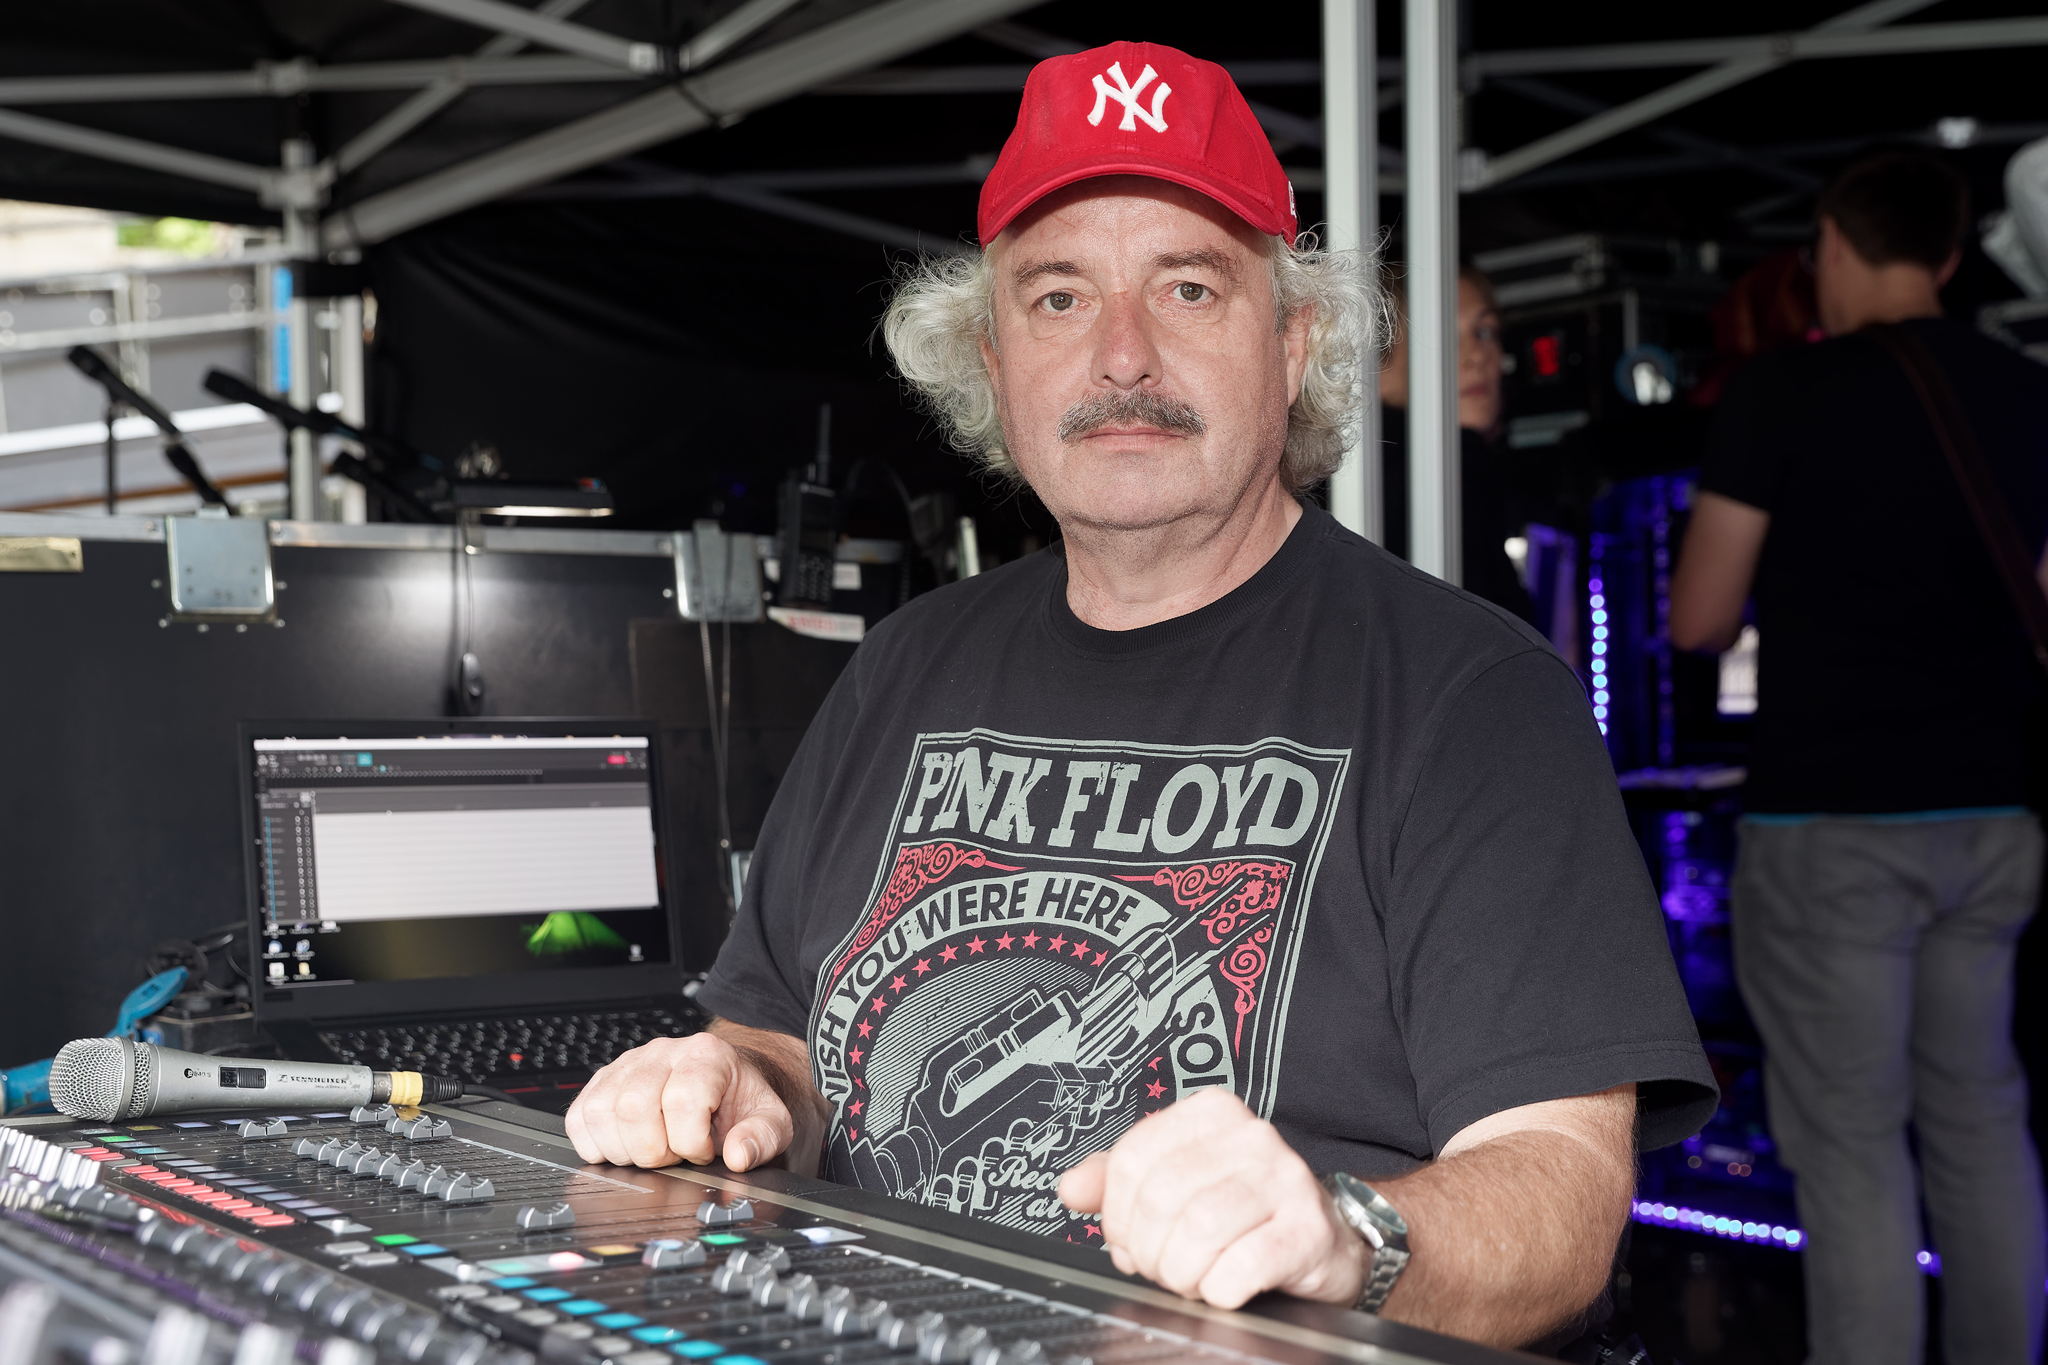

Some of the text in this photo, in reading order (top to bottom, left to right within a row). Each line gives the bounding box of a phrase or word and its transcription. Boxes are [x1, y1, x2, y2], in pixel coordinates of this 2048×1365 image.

[1087, 61, 1172, 133] NY
[1047, 757, 1319, 854] FLOYD
[838, 923, 908, 1004] YOU
[915, 878, 1030, 940] WERE
[1035, 877, 1140, 937] HERE
